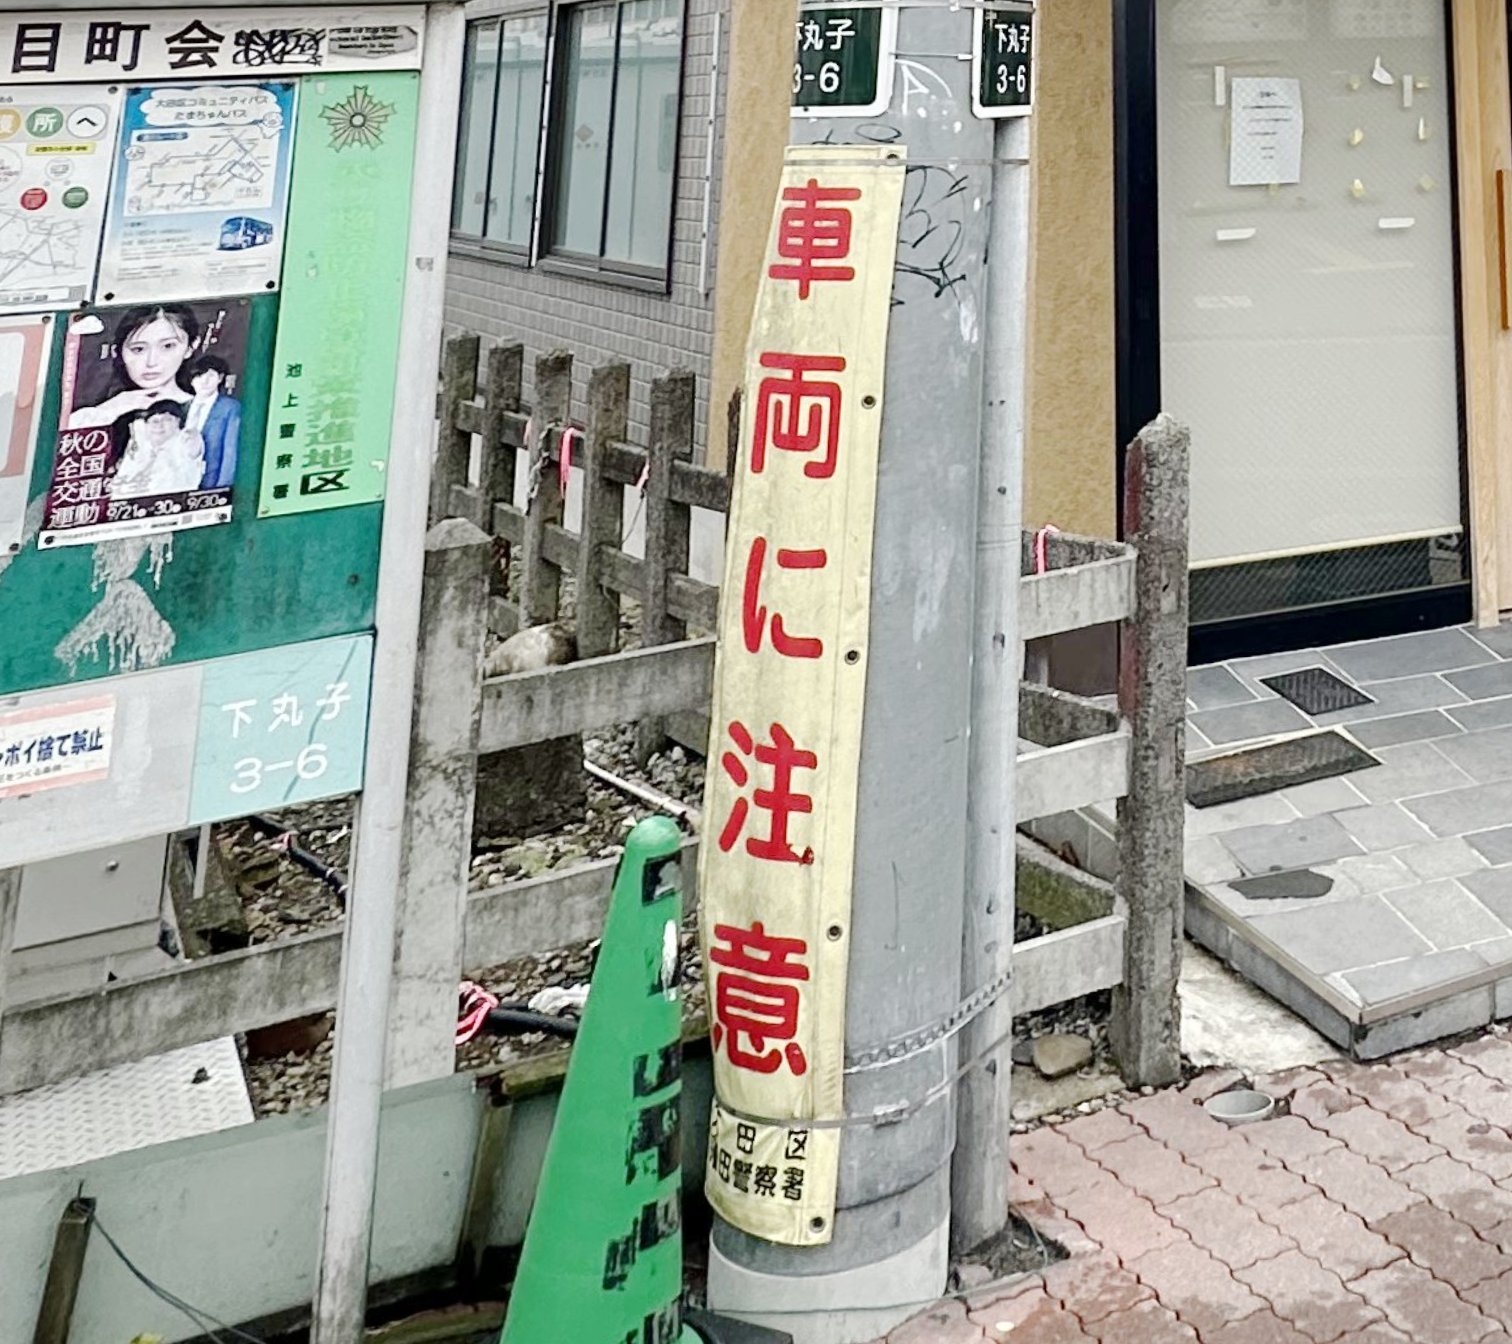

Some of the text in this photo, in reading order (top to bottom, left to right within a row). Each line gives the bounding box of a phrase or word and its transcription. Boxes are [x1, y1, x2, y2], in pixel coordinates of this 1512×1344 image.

[994, 23, 1031, 54] 下丸子
[996, 64, 1027, 94] 3-6
[59, 429, 109, 456] 秋の
[56, 454, 105, 482] 全国
[48, 502, 100, 530] 運動
[709, 178, 862, 1077] 車両に注意
[221, 681, 352, 739] 下丸子
[229, 742, 329, 794] 3-6
